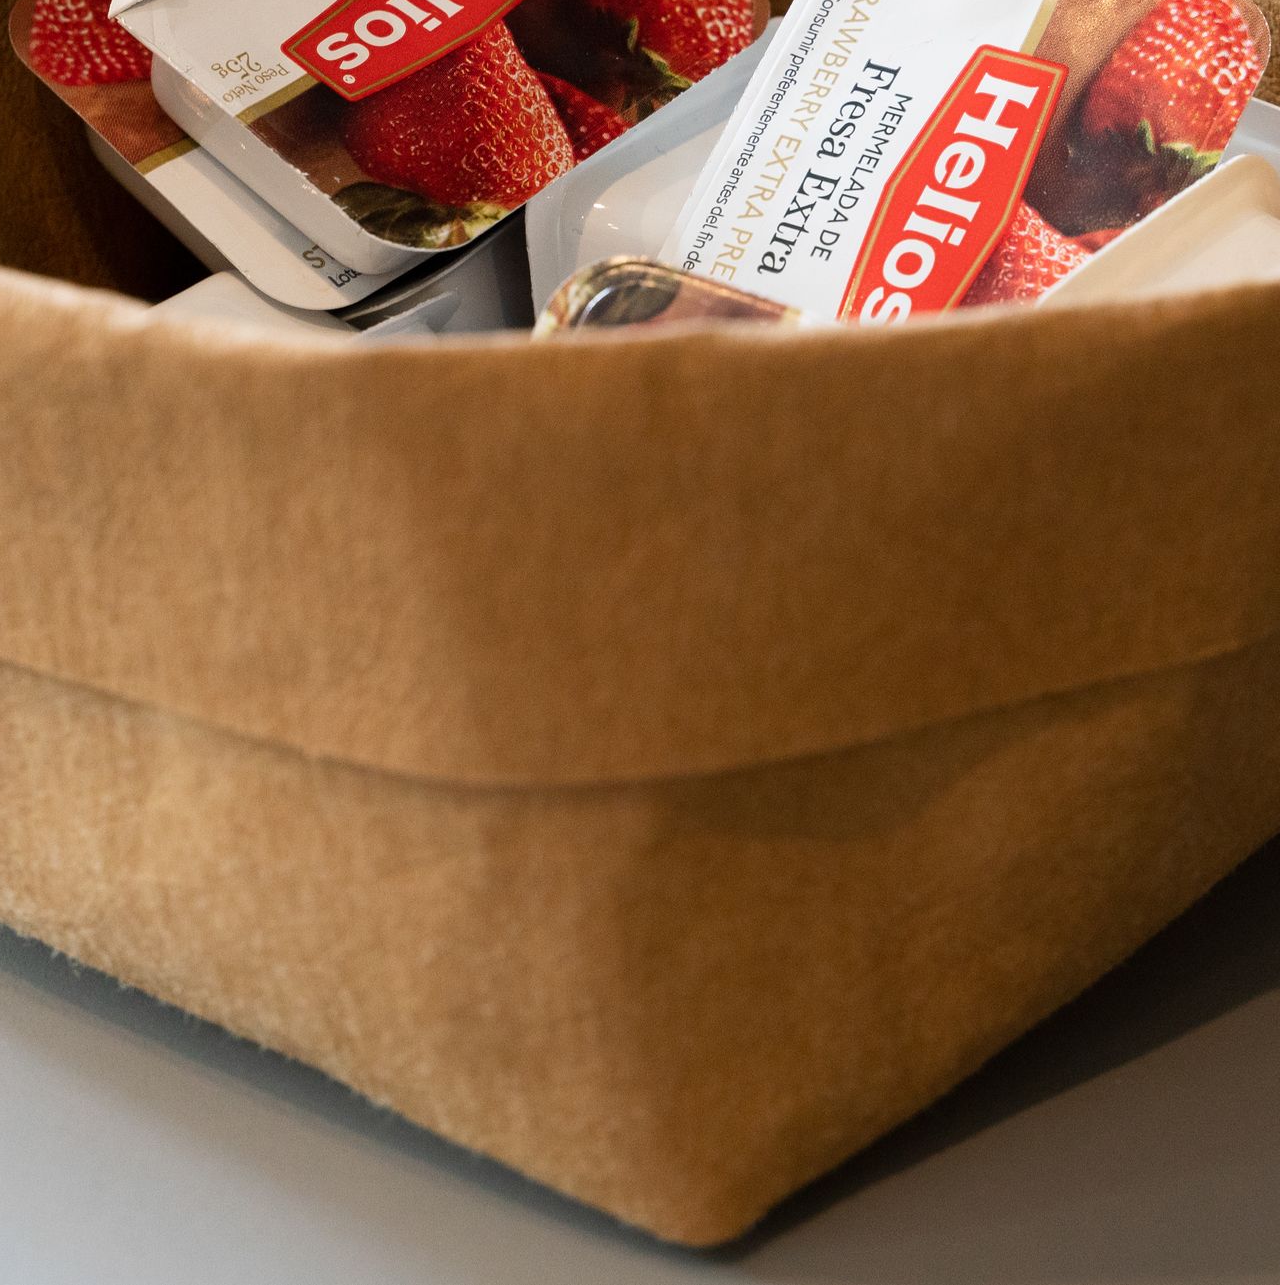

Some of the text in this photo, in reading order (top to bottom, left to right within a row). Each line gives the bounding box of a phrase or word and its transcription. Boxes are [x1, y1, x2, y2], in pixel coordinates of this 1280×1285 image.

[209, 50, 262, 81] 25g
[220, 61, 289, 103] Peso Neto
[734, 52, 807, 169] preferentemente
[714, 165, 745, 208] antes
[735, 133, 802, 221] EXTRA
[755, 58, 901, 279] Fresa Extra
[809, 92, 913, 262] MERMELADA DE
[700, 204, 727, 233] del
[860, 72, 1039, 327] Helios
[691, 230, 716, 251] fin
[709, 226, 754, 281] PRE
